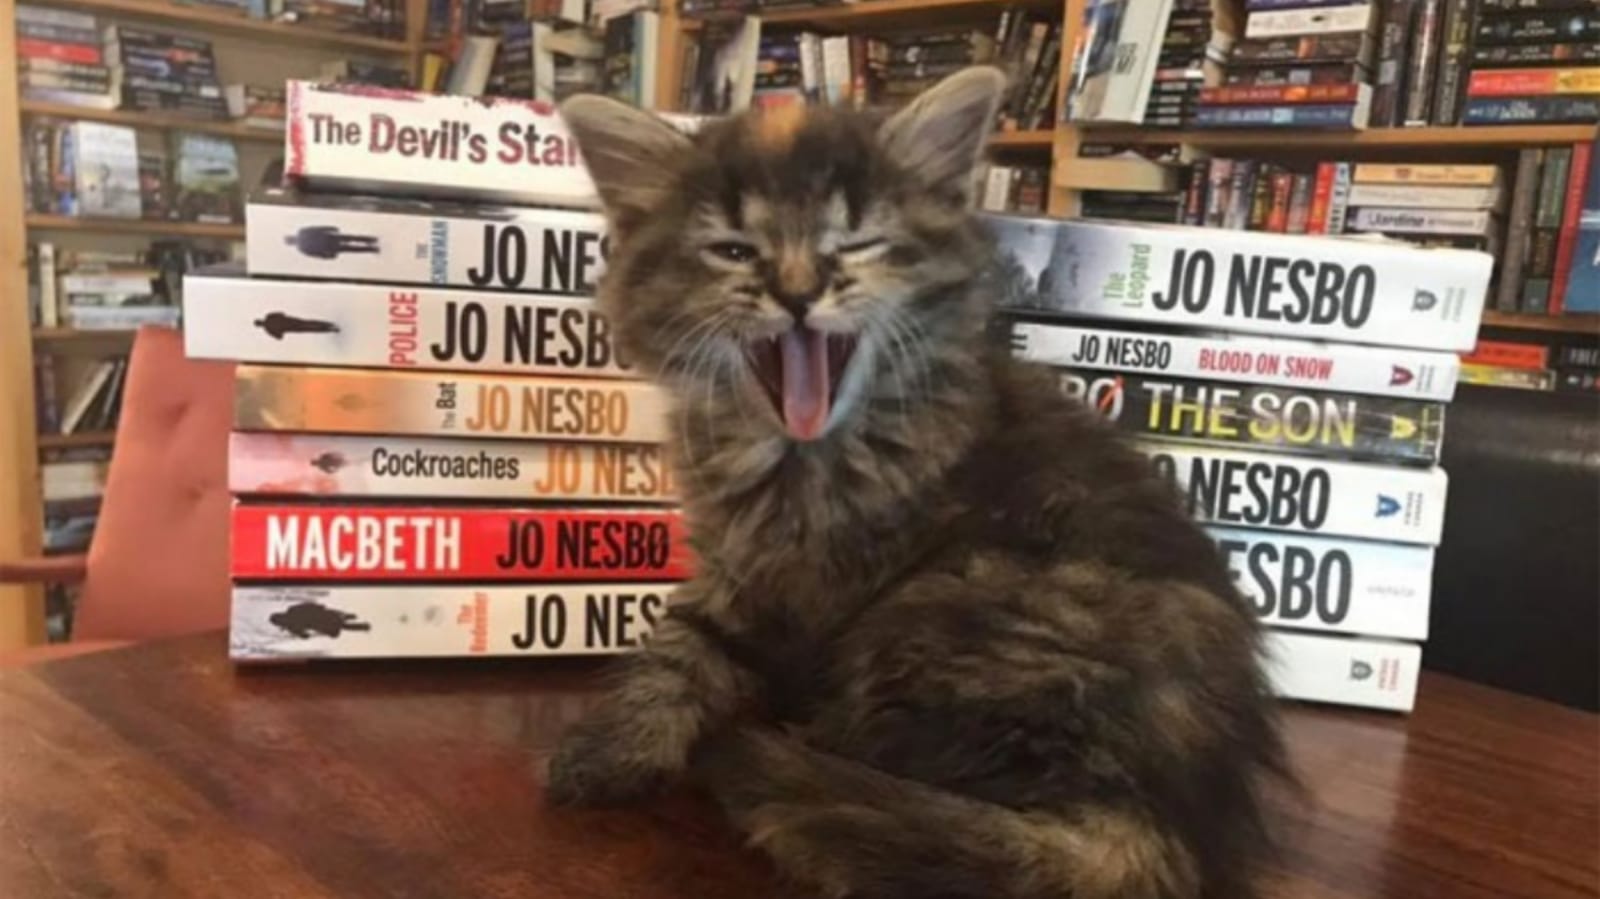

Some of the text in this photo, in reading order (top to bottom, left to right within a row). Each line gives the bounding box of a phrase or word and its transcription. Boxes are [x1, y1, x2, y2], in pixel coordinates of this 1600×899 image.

[307, 112, 361, 146] The
[368, 112, 488, 165] Devil's
[467, 224, 527, 290] JO
[1121, 243, 1152, 309] Leopard
[1151, 248, 1215, 314] JO
[1224, 252, 1376, 330] NESBO
[388, 292, 419, 368] POLICE
[429, 300, 488, 363] JO
[1072, 334, 1335, 380] JO NESBO BLOOD ON SNOW
[435, 382, 457, 410] Bat
[465, 383, 630, 437] JO NESBO
[1141, 380, 1242, 437] THE
[1247, 391, 1357, 449] SON
[371, 447, 520, 480] Cockroaches
[534, 444, 582, 495] JO
[1187, 456, 1332, 531] NESBO
[265, 514, 461, 571] MACBETH
[495, 518, 545, 570] JO
[512, 592, 567, 650] JO
